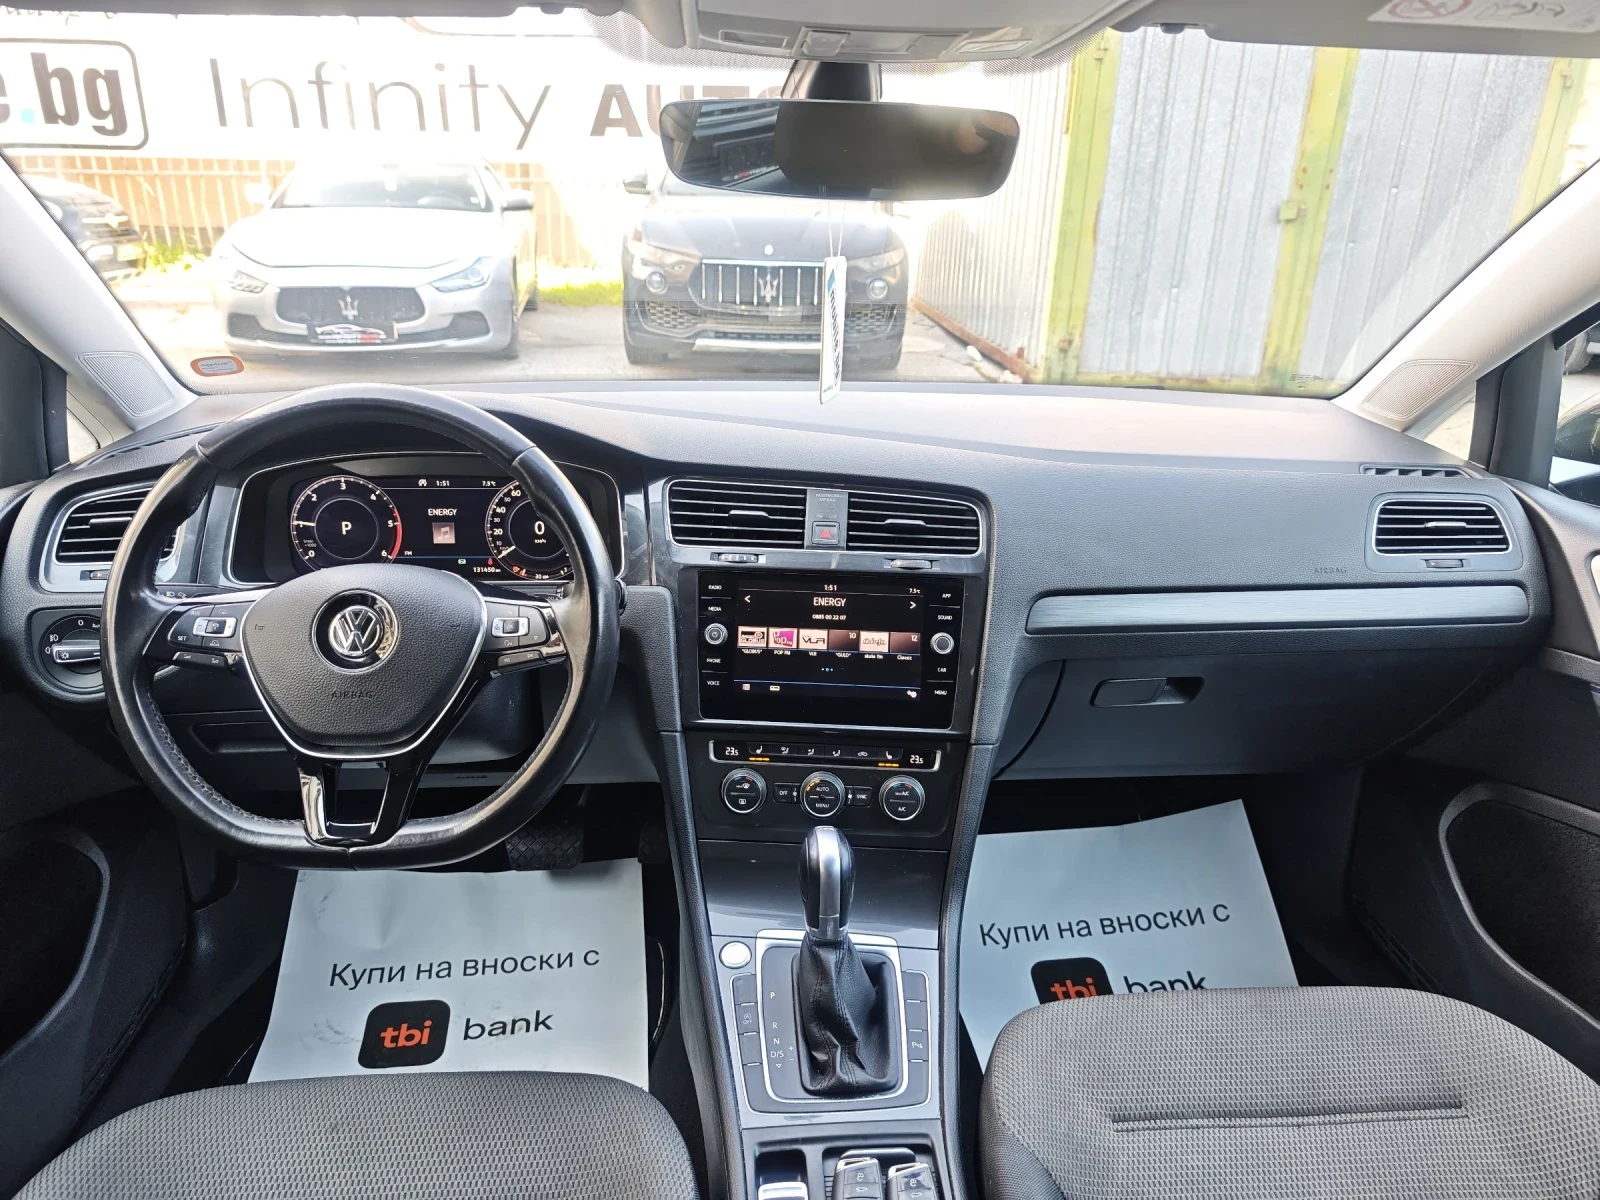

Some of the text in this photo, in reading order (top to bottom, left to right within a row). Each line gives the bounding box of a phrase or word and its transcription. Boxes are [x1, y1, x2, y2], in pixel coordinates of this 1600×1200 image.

[0, 52, 128, 137] .bg
[209, 58, 552, 150] Infinity
[340, 482, 346, 490] 3
[311, 493, 318, 501] 2
[370, 493, 376, 501] 4
[428, 508, 457, 516] ENERGY
[341, 521, 352, 535] P
[534, 521, 545, 535] 0
[1314, 567, 1347, 575] AIRBAG
[813, 597, 846, 607] ENERGY
[978, 922, 1049, 950] Купи
[1056, 919, 1093, 940] на
[1100, 906, 1206, 936] вноски
[329, 963, 406, 991] Купи
[415, 960, 452, 981] на
[462, 950, 574, 977] вноски
[770, 991, 776, 999] P
[380, 1009, 555, 1050] tbi bank
[772, 1021, 778, 1029] R
[770, 1050, 784, 1058] D/S
